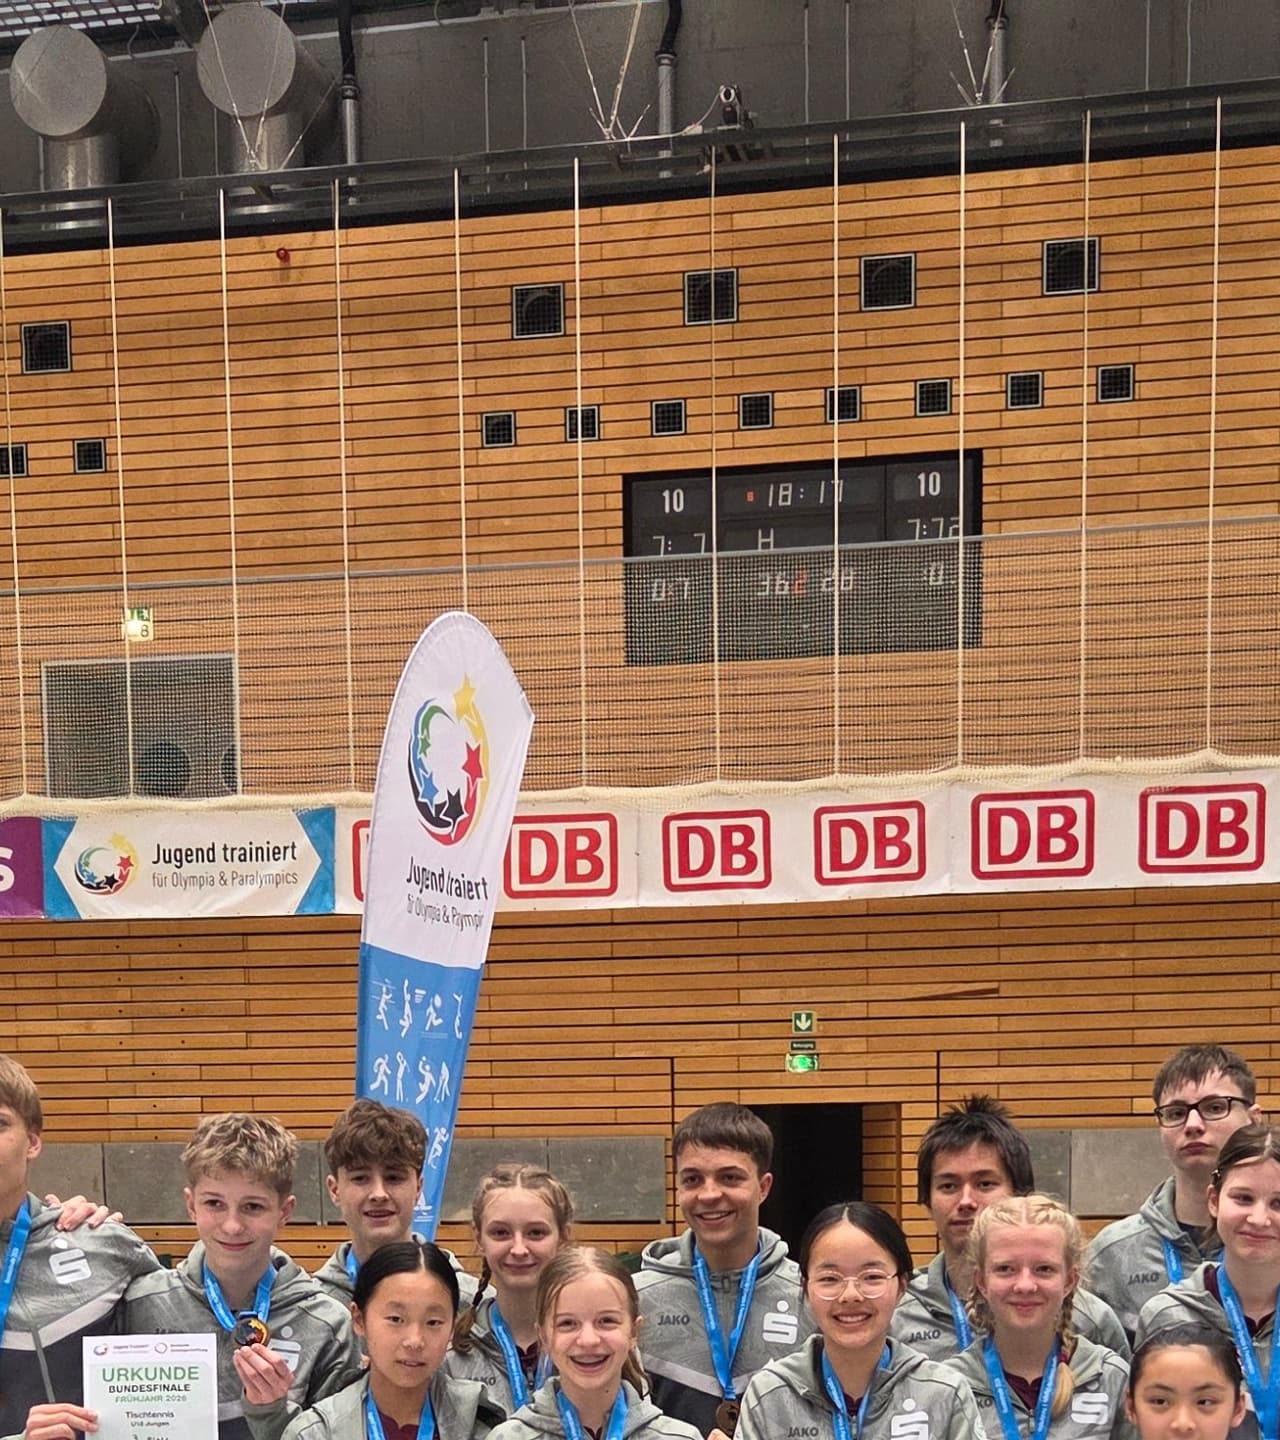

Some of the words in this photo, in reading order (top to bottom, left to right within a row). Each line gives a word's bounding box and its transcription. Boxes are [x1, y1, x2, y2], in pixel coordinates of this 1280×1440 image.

[917, 471, 941, 497] 10
[661, 488, 685, 514] 10
[986, 805, 1080, 866] DB
[1155, 797, 1249, 859] DB
[151, 840, 216, 869] Jugend
[221, 840, 298, 864] trainiert
[676, 823, 759, 878] DB
[828, 815, 913, 871] DB
[518, 832, 607, 885] DB
[151, 872, 168, 888] für
[171, 870, 215, 891] Olympia
[218, 871, 230, 887] &
[231, 868, 299, 889] Paralympics
[1128, 1271, 1160, 1285] JAKO
[658, 1314, 690, 1325] JAKO
[909, 1329, 941, 1343] JAKO
[102, 1366, 200, 1382] URKUNDE
[108, 1384, 192, 1393] BUNDESFINALE
[125, 1411, 175, 1419] Tischtennis
[787, 1426, 819, 1438] JAKO
